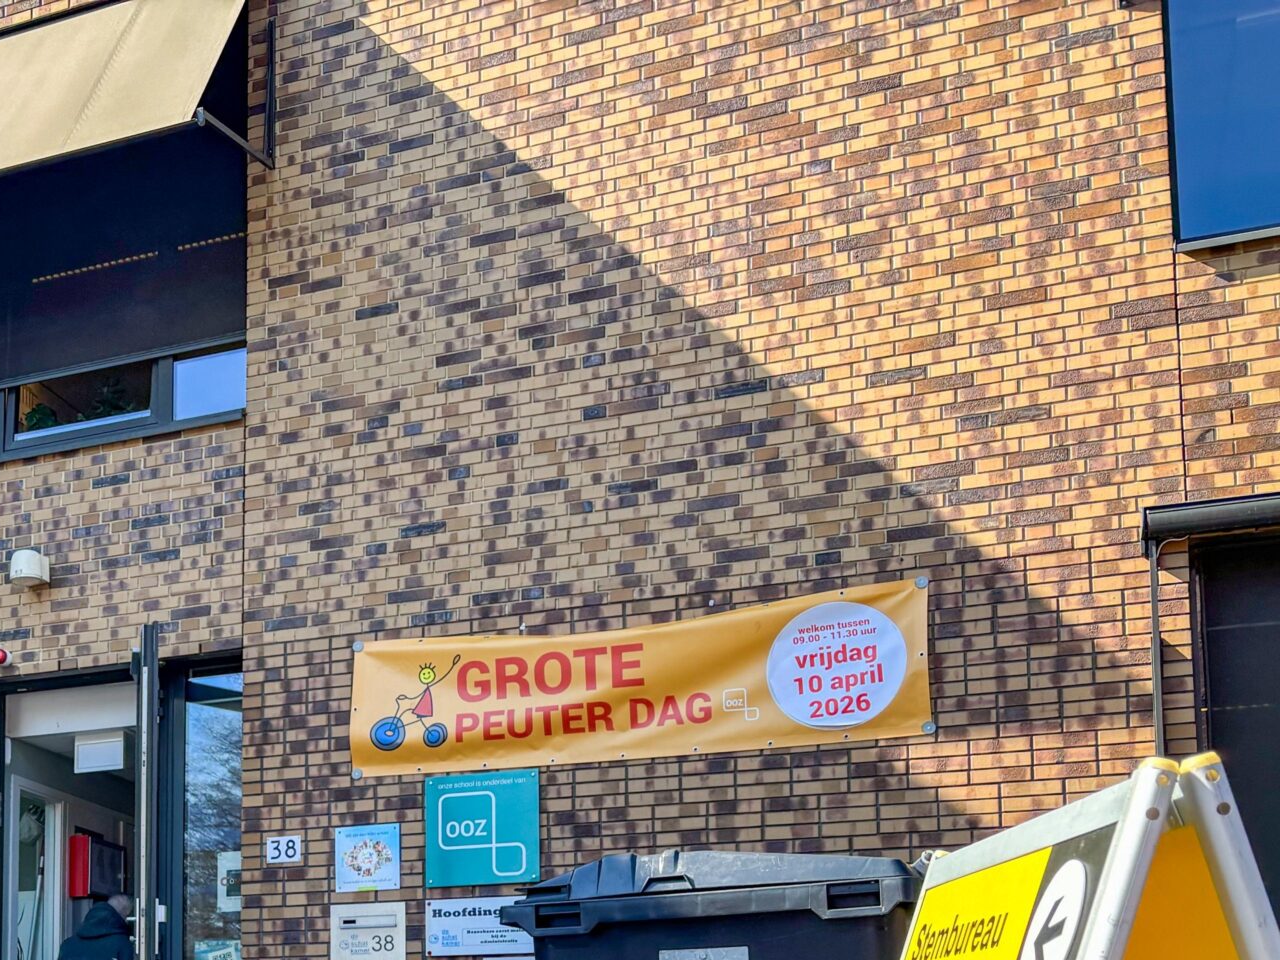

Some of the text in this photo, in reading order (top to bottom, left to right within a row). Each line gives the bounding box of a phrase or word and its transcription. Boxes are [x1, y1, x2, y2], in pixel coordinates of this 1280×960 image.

[793, 634, 820, 645] 09.00
[831, 629, 858, 640] 11.30
[861, 626, 877, 635] uur
[798, 619, 870, 634] welkom tussen
[795, 643, 878, 670] vrijdag
[456, 643, 645, 703] GROTE
[794, 663, 884, 695] 10 april
[809, 693, 871, 718] 2026
[455, 692, 713, 743] PEUTER DAG
[454, 781, 475, 789] school
[482, 778, 513, 786] onderdeel
[271, 839, 297, 860] 38
[372, 935, 395, 952] 38
